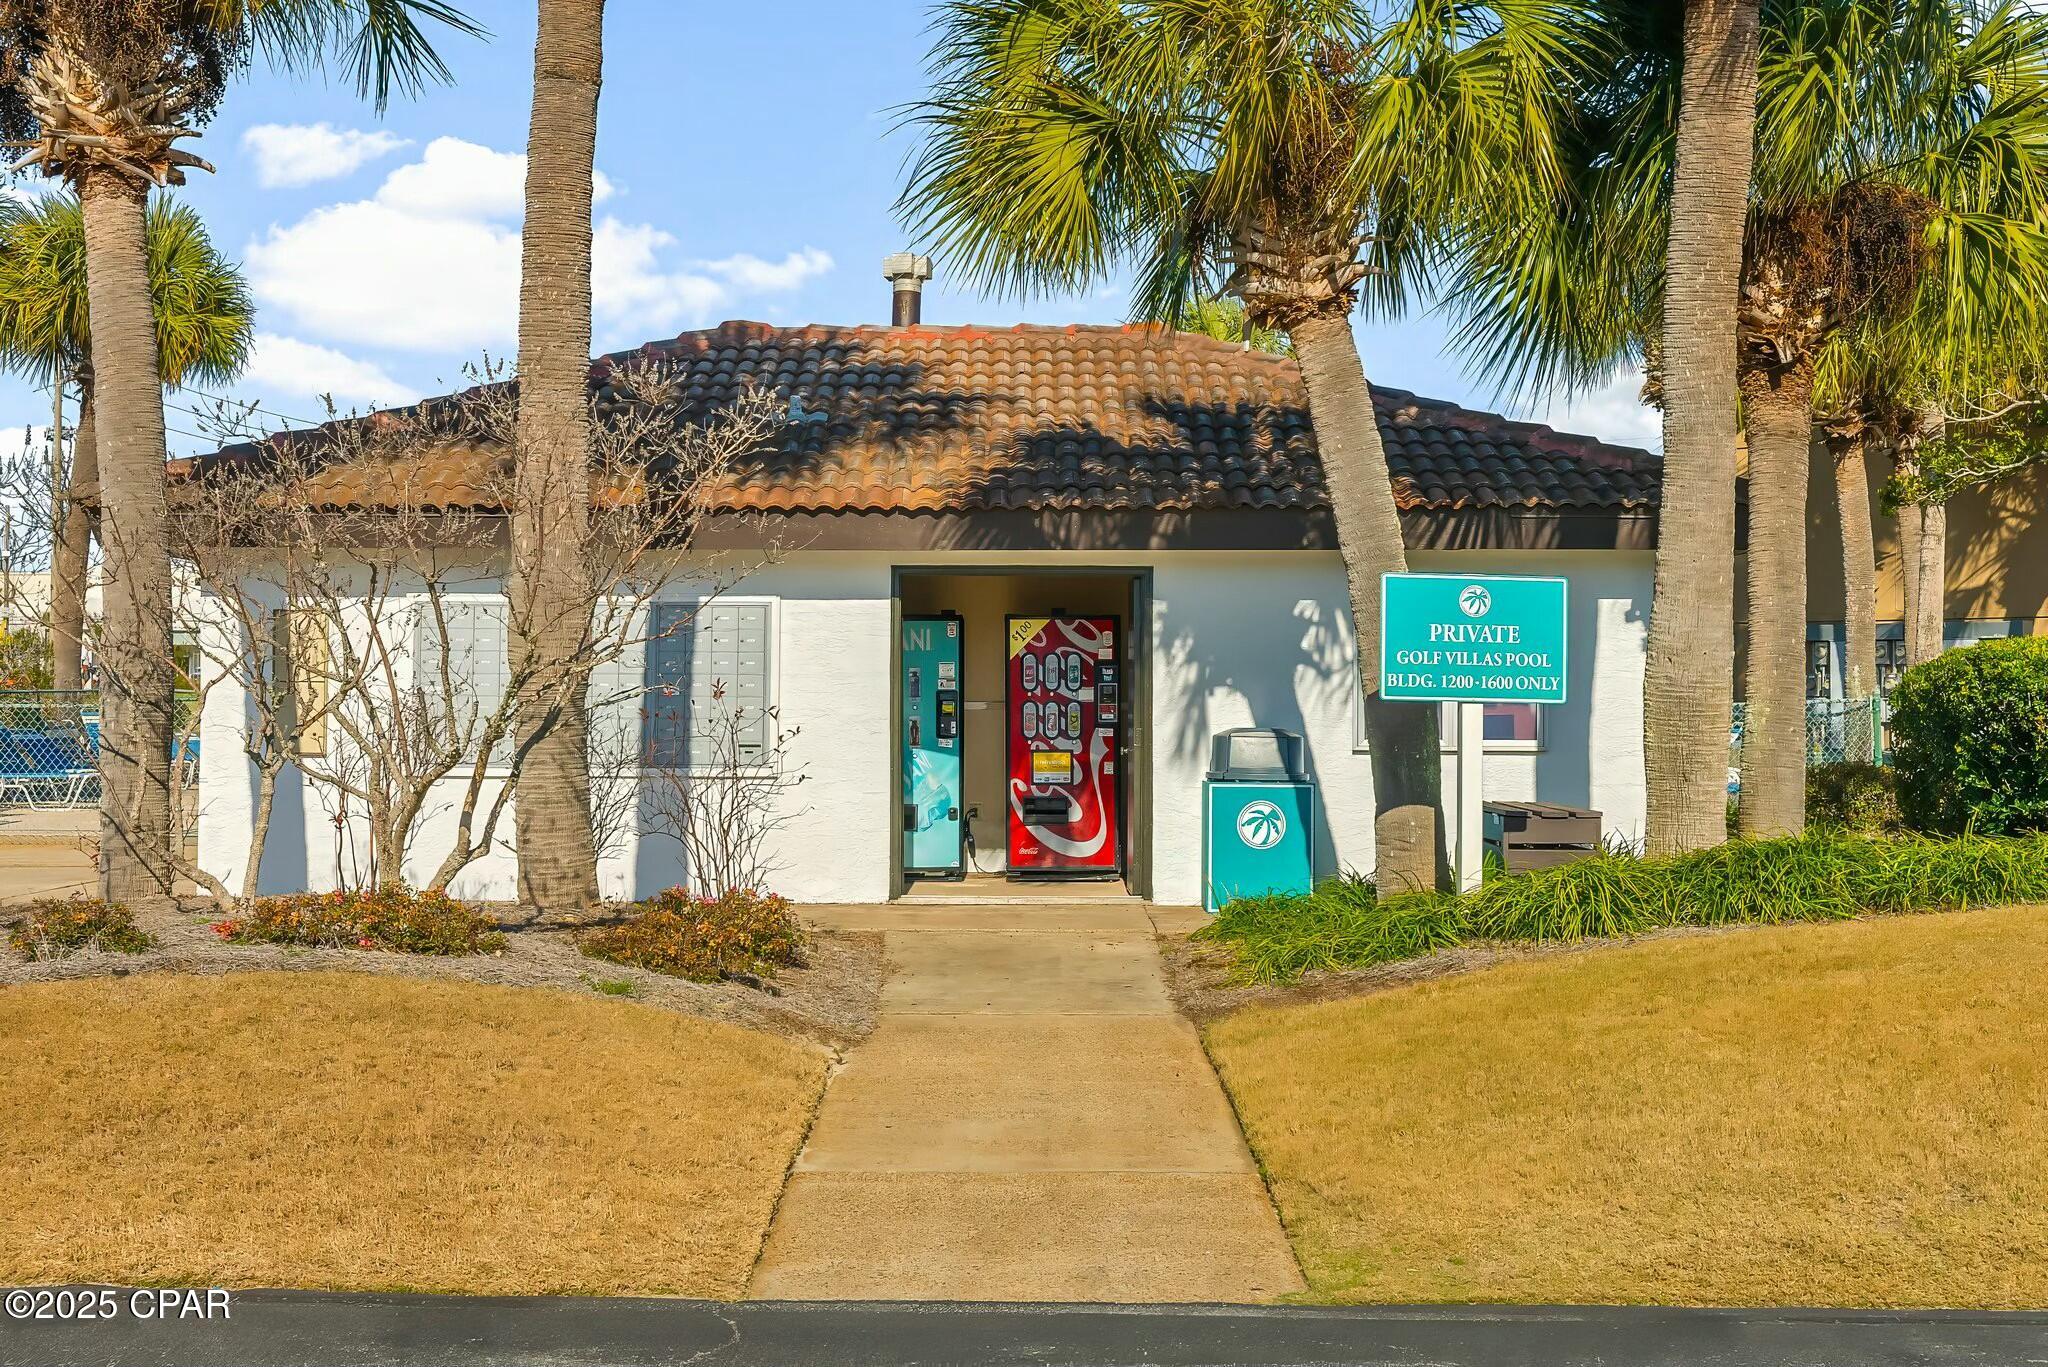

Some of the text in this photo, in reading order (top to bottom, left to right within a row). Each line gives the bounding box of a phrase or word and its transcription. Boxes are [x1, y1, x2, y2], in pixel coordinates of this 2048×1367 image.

[1428, 623, 1521, 644] PRIVATE
[1396, 650, 1552, 668] GOLF VILLAS POOL
[1386, 673, 1437, 688] BLDG.
[1515, 675, 1561, 691] ONLY
